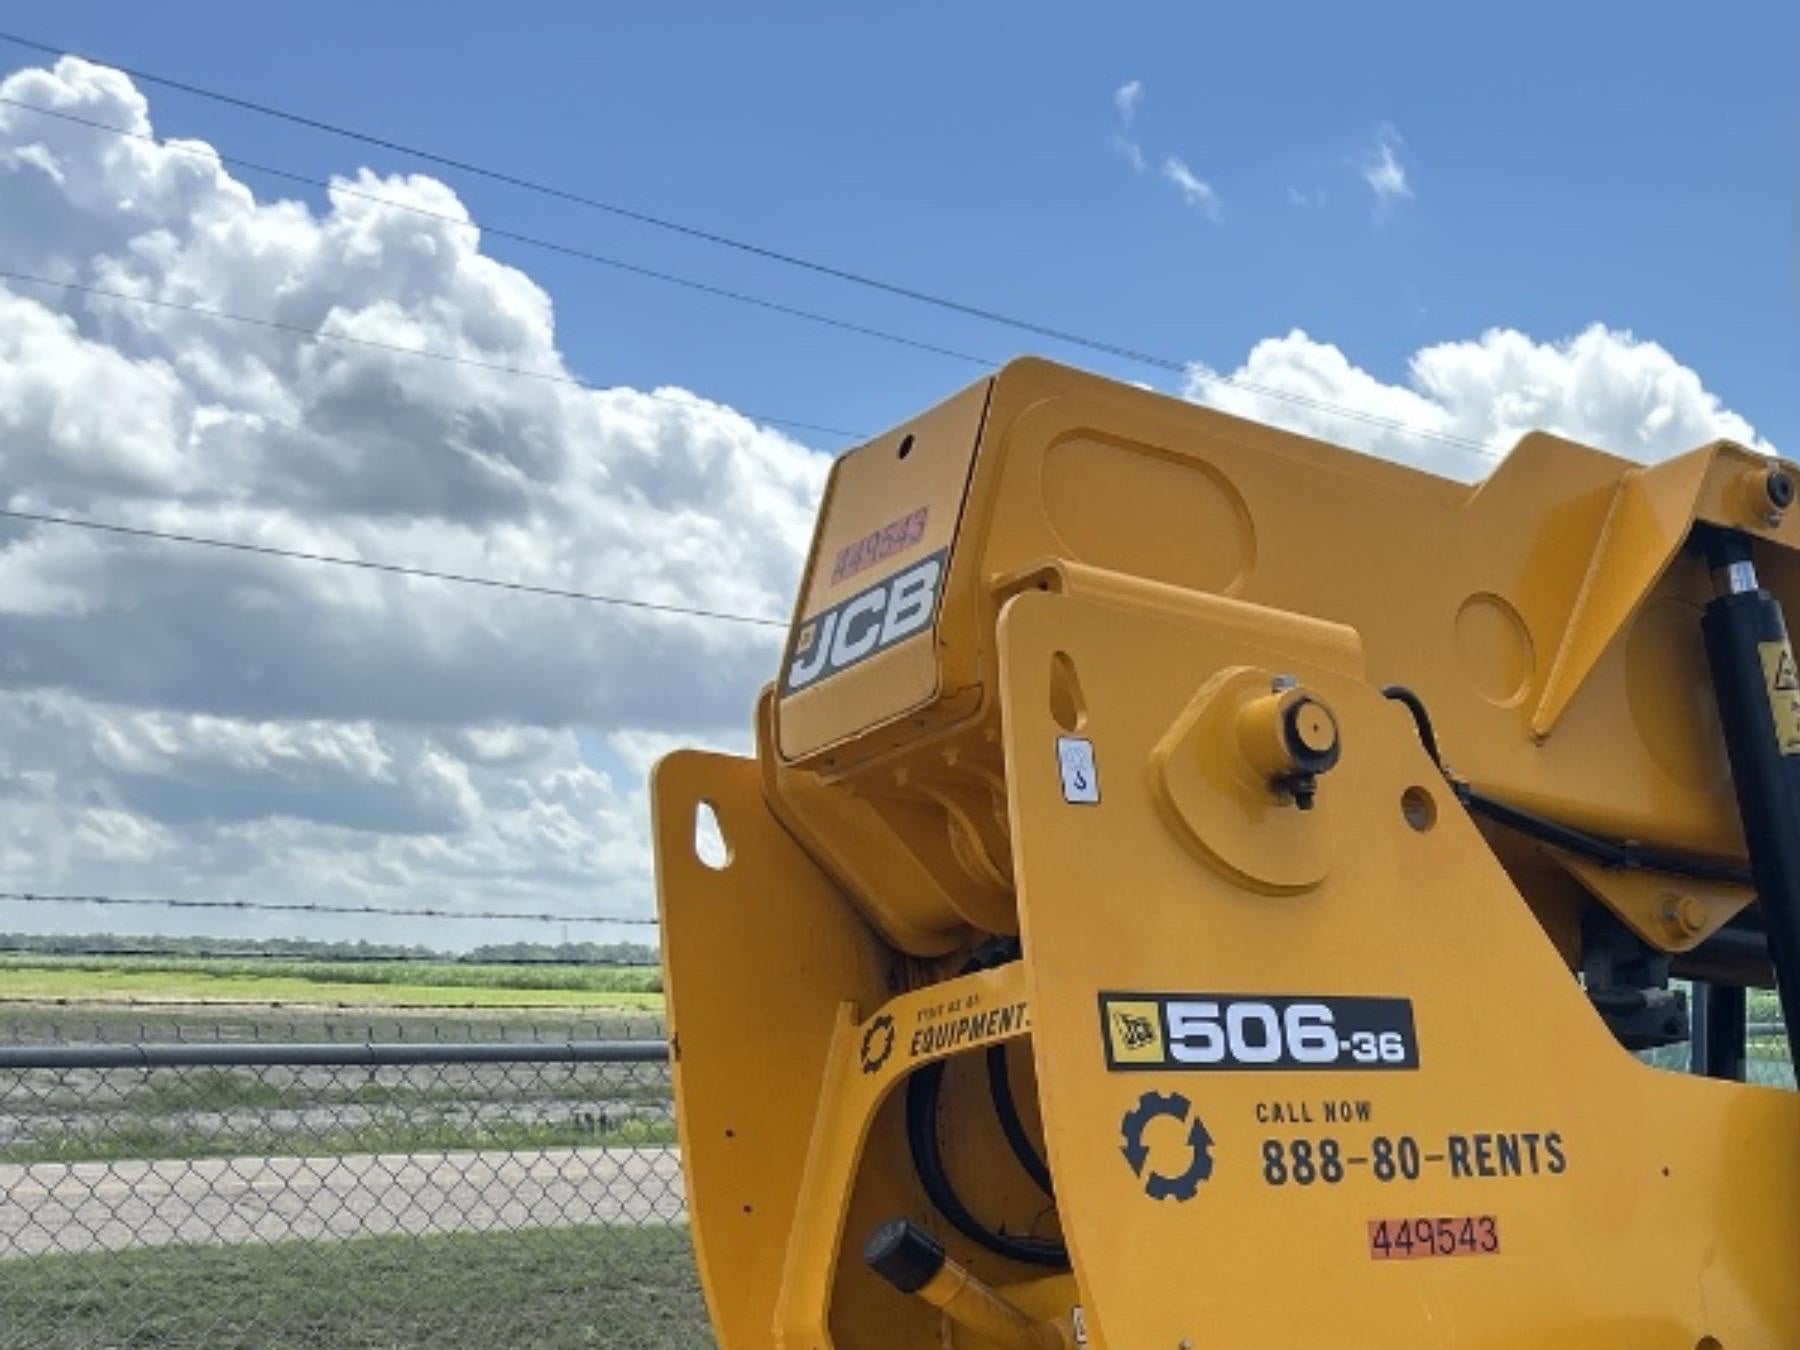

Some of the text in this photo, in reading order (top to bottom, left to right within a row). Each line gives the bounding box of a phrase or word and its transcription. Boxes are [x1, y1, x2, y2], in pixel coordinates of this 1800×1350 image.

[788, 560, 940, 688] JCB
[910, 1002, 1032, 1056] EQUIPMENT
[1166, 1002, 1405, 1063] 506-36
[1256, 1101, 1371, 1123] CALL NOW
[1262, 1132, 1567, 1186] 888-80-RENTS
[1372, 1215, 1498, 1257] 449543
